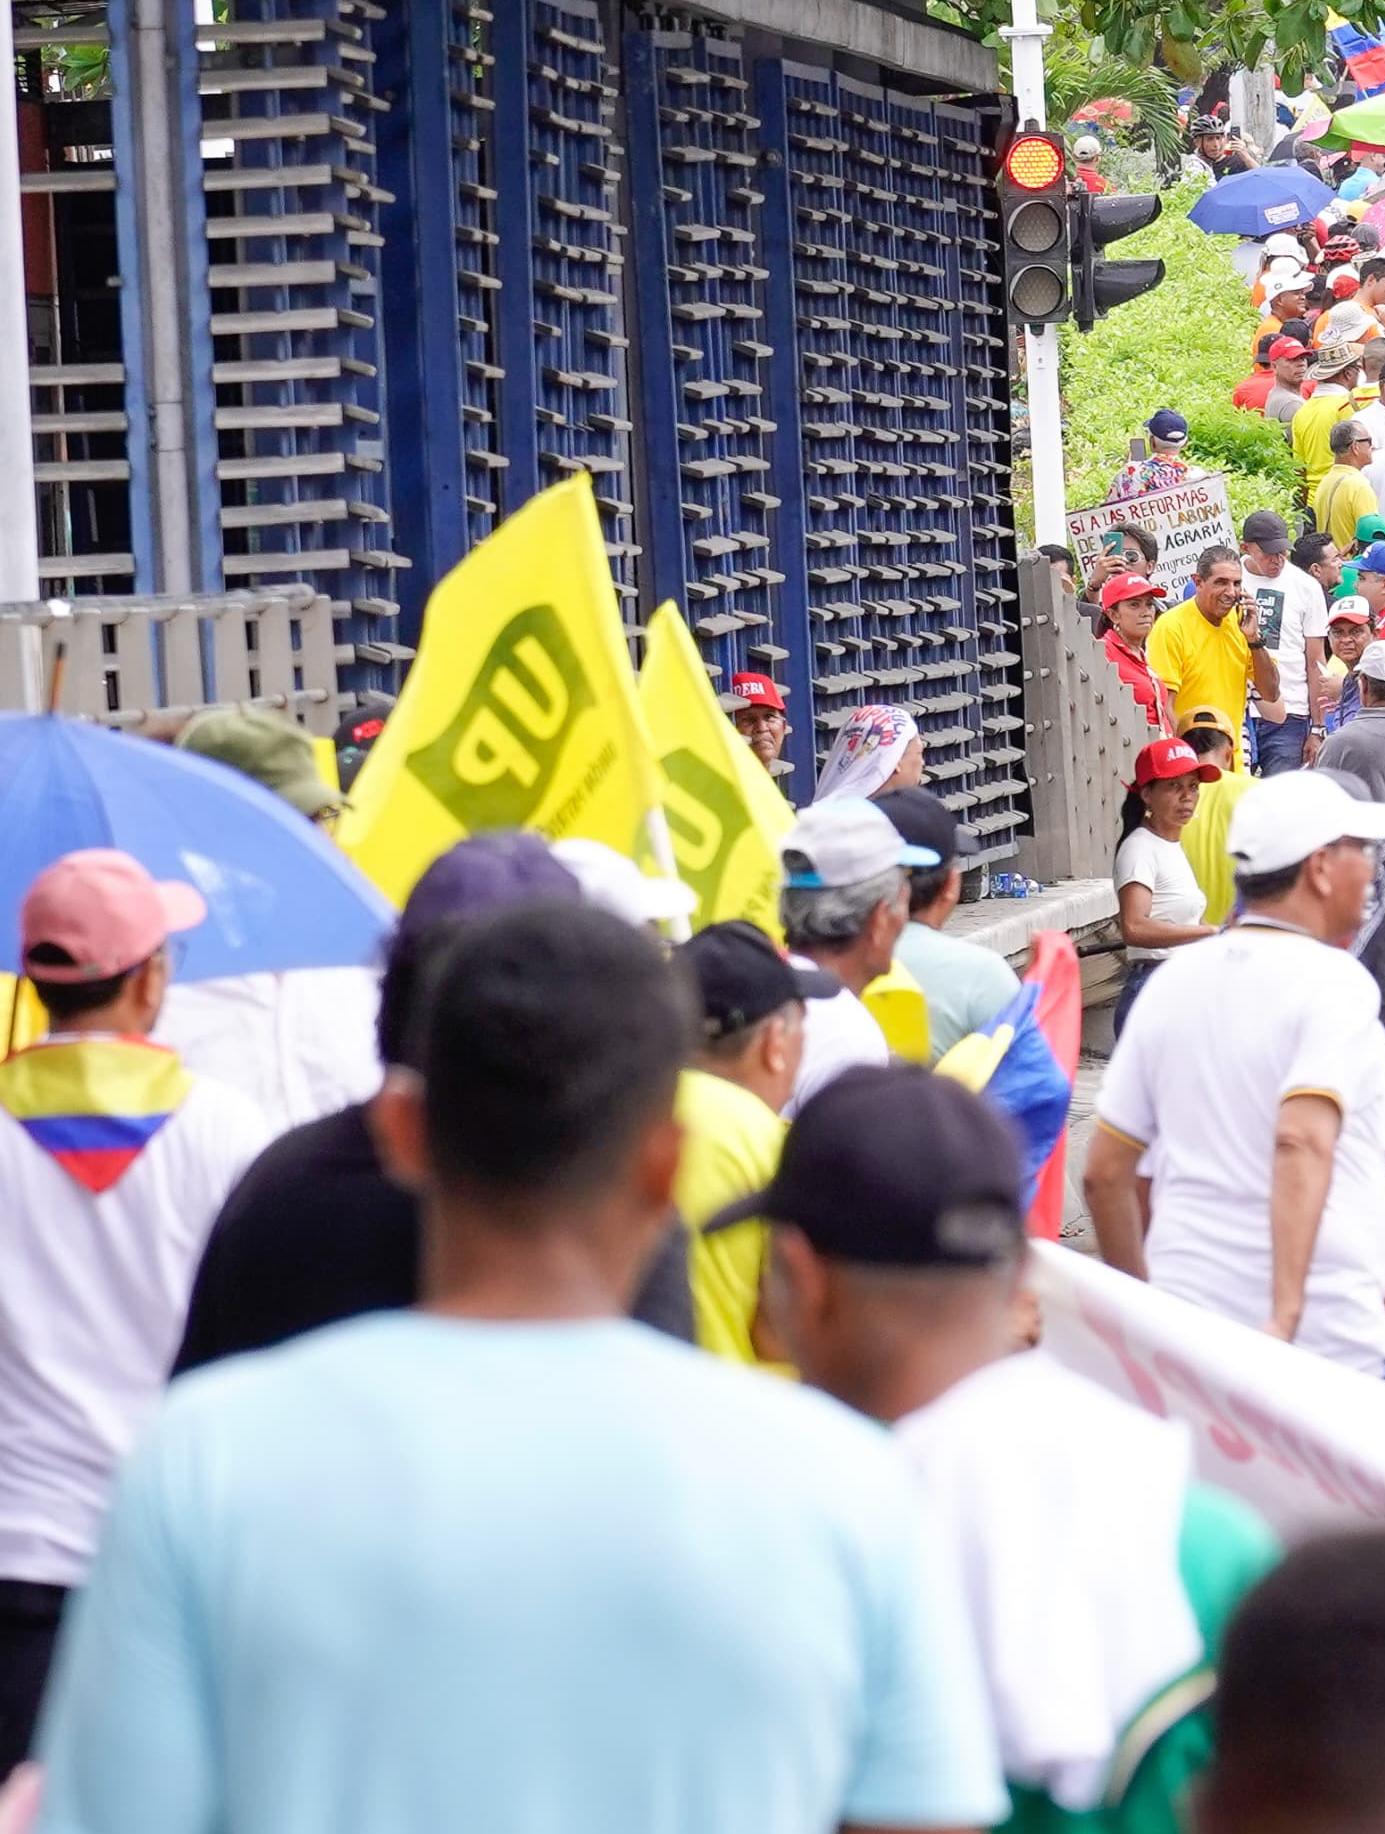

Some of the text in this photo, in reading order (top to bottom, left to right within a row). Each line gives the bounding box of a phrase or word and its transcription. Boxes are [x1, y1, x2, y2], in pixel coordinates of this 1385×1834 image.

[1090, 515, 1101, 532] A
[1103, 508, 1126, 526] LAS
[1128, 487, 1208, 520] REFORMAS
[1168, 500, 1225, 528] LABORAL
